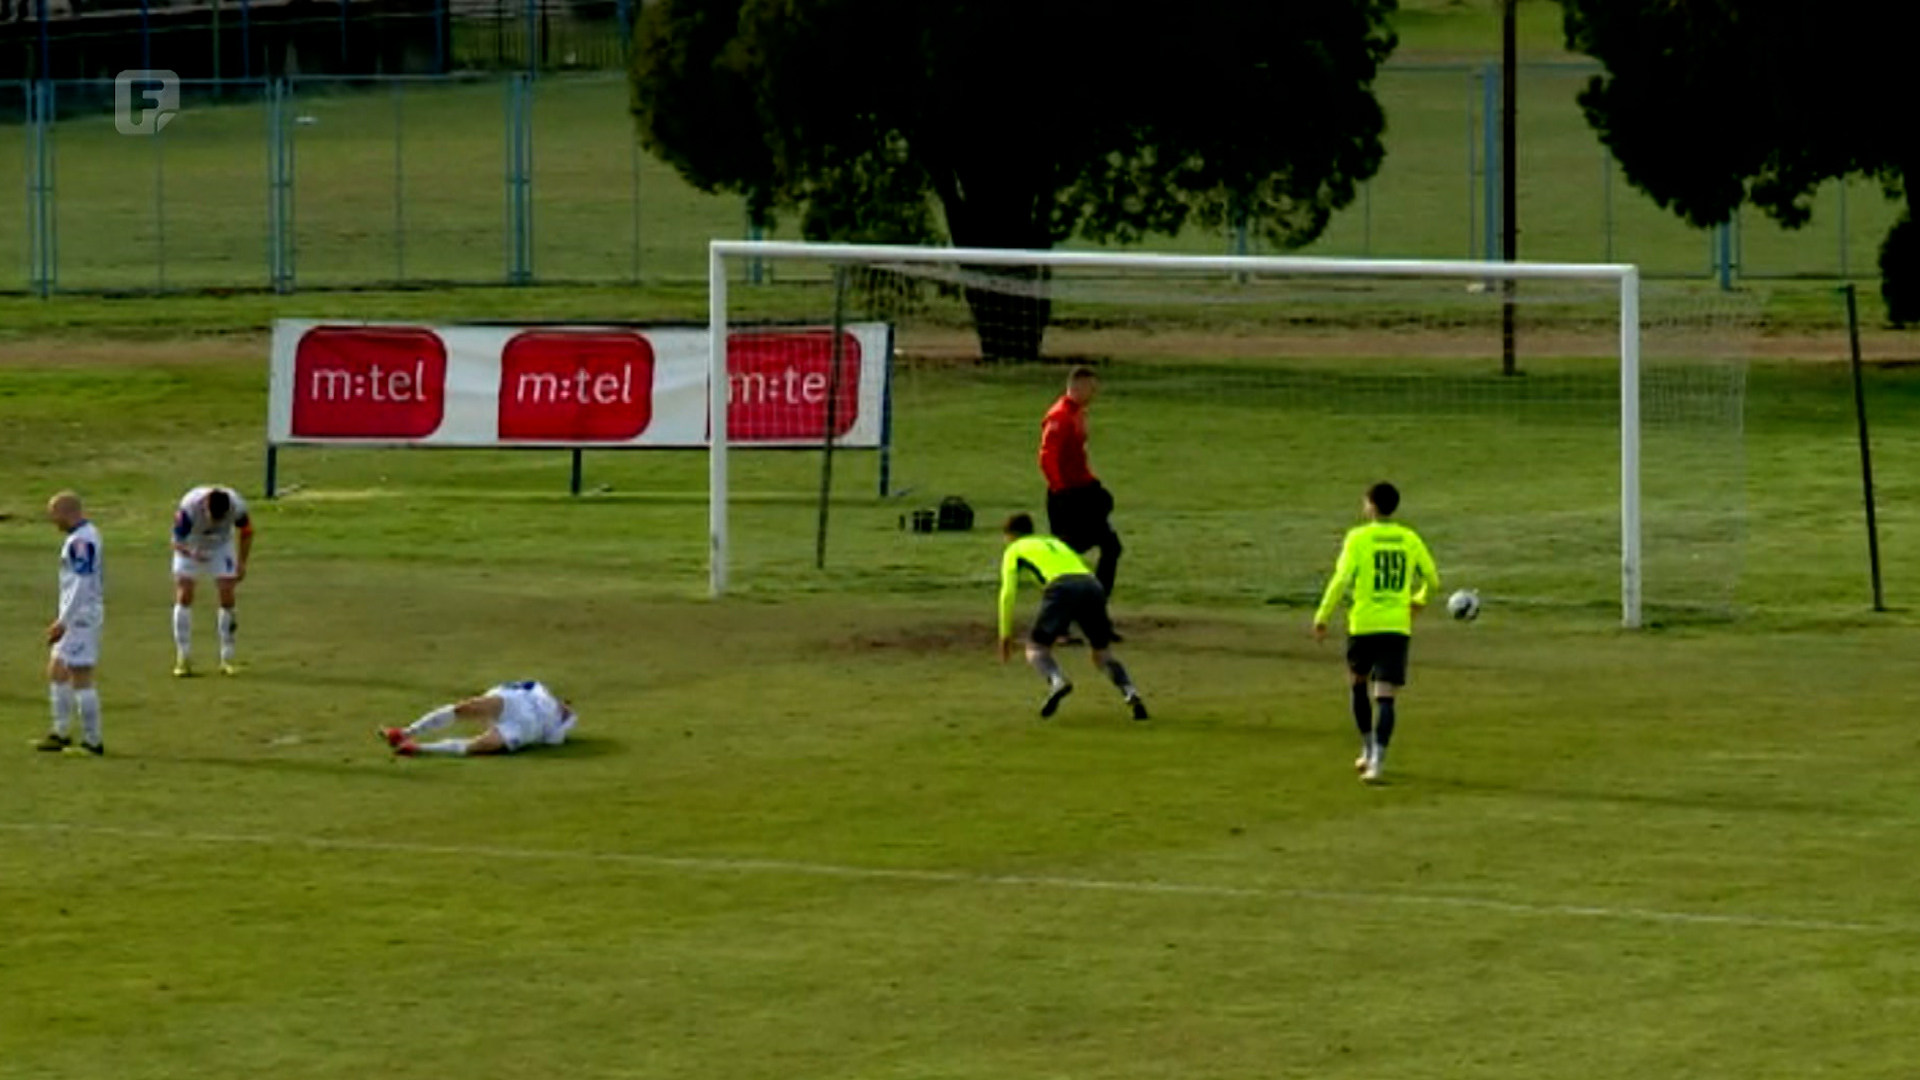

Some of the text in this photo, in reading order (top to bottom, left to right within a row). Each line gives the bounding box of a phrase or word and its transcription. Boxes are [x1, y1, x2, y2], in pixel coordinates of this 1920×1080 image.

[311, 359, 832, 404] m:tel m:tel m:te
